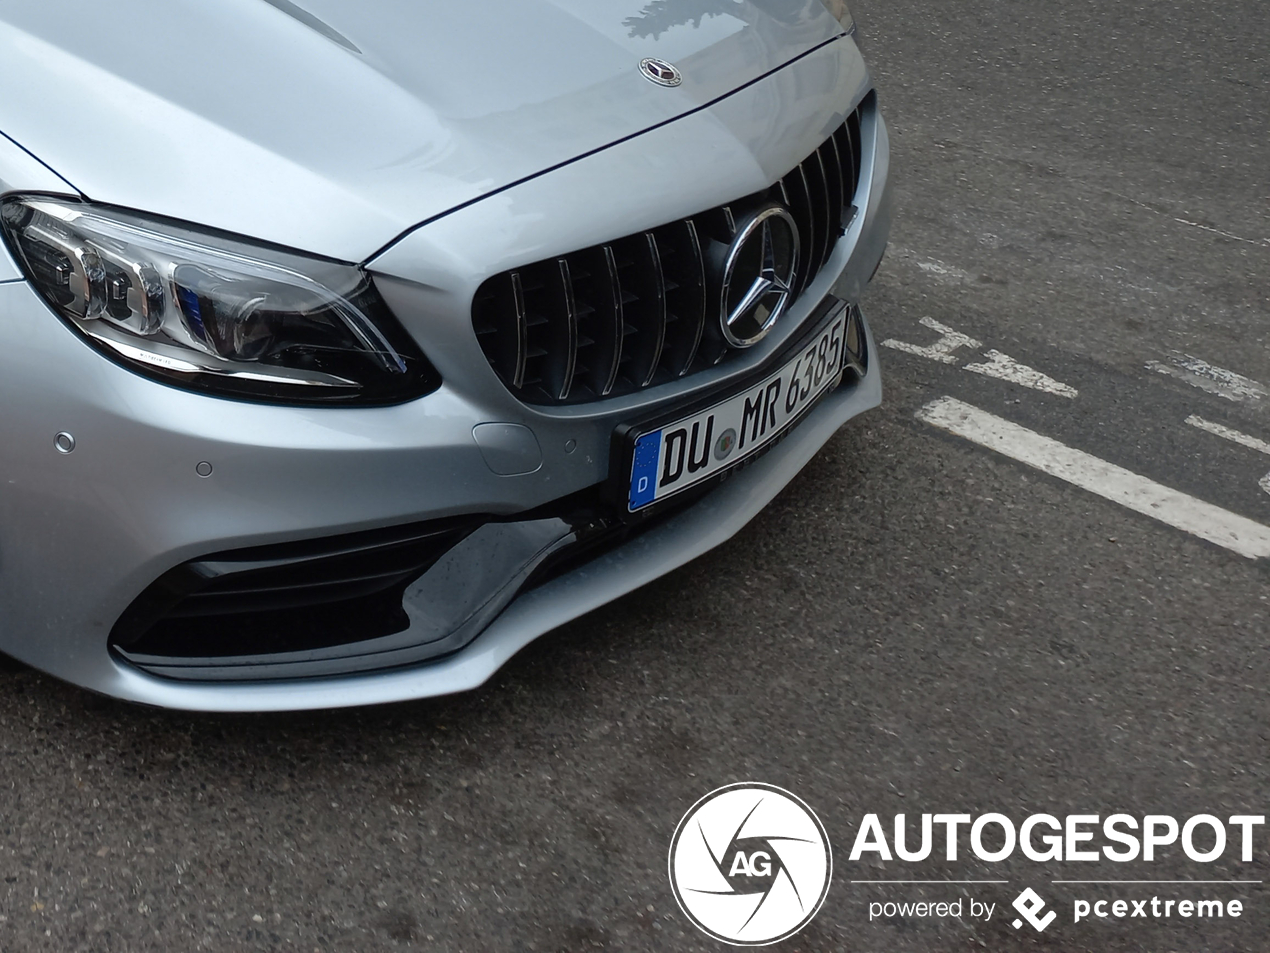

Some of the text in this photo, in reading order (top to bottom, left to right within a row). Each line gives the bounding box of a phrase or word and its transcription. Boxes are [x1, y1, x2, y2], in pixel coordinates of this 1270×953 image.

[637, 476, 648, 494] D
[659, 414, 714, 488] DU
[738, 377, 781, 450] MR
[785, 320, 843, 415] 6385
